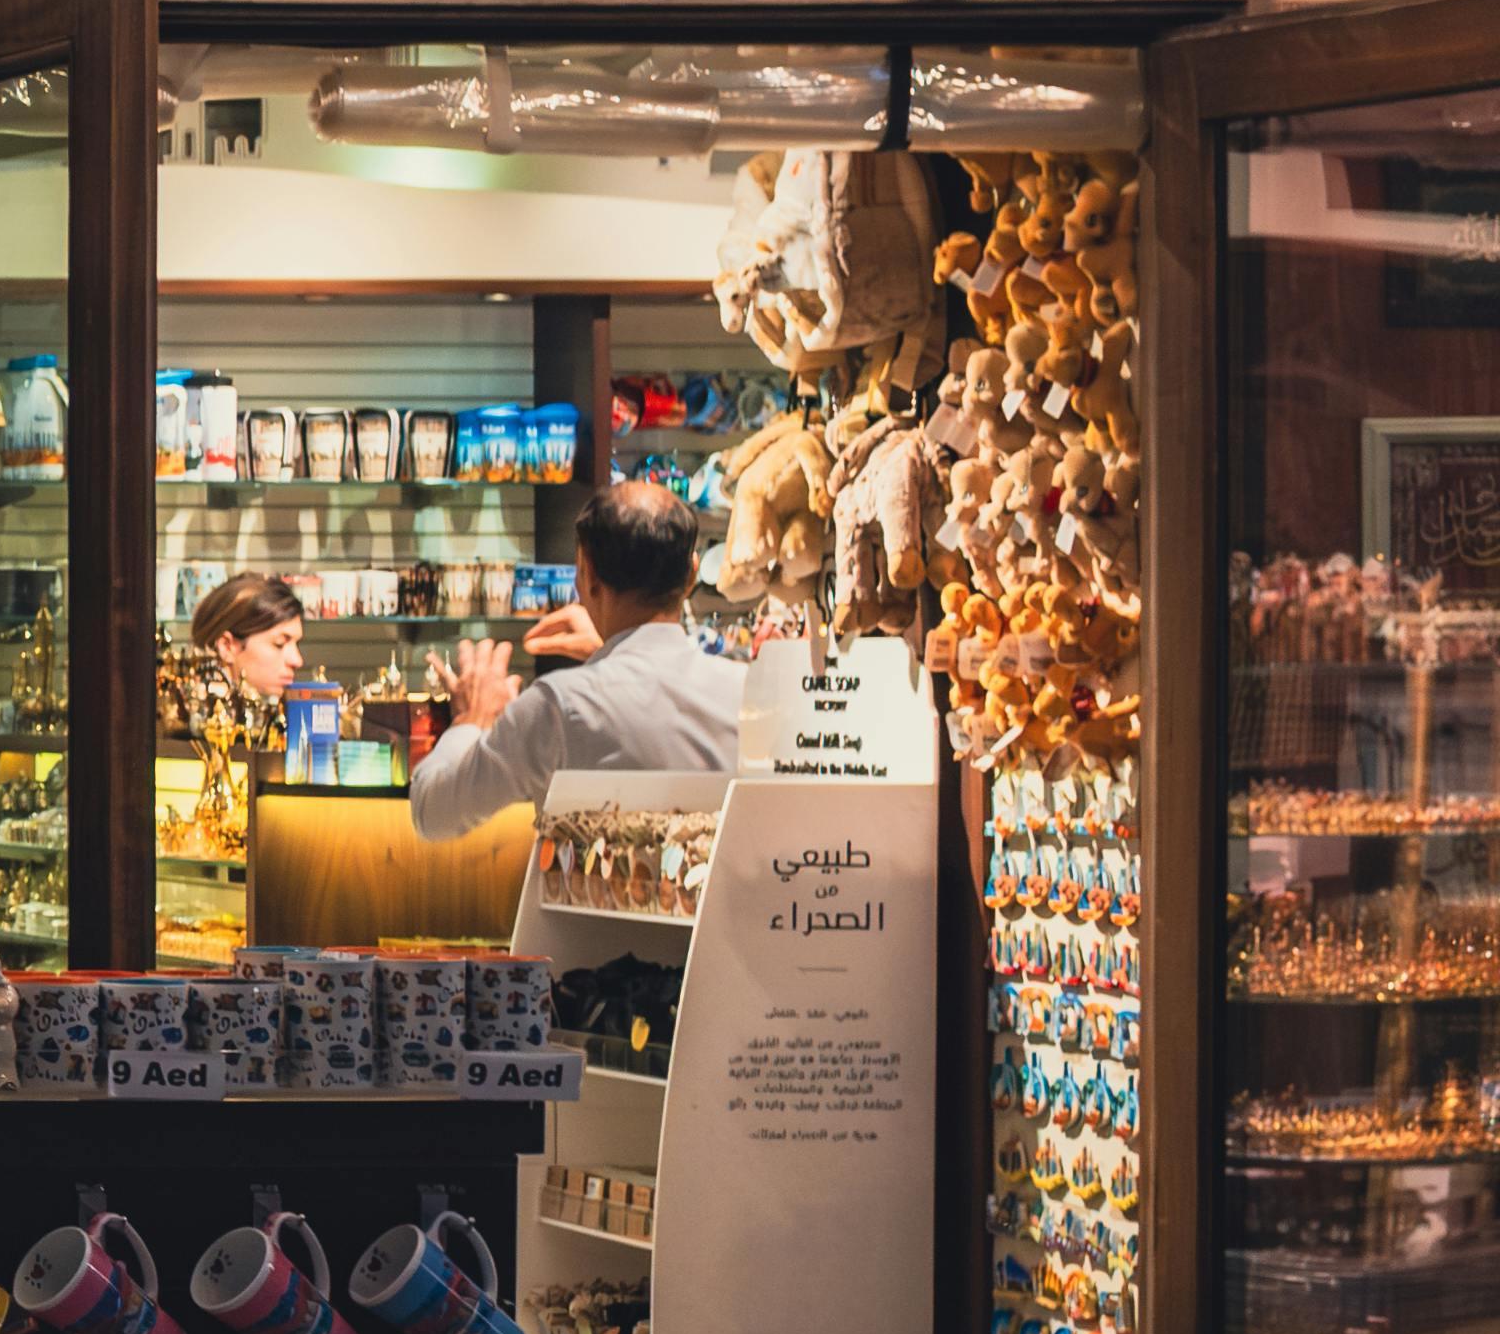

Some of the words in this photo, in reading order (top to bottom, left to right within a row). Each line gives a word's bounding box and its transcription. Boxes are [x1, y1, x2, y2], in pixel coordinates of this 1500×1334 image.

[773, 839, 871, 883] طبيعي
[814, 883, 839, 899] من
[770, 901, 884, 936] الصحراء
[112, 1060, 131, 1085] 9
[141, 1061, 207, 1087] Aed
[468, 1062, 487, 1086] 9
[497, 1064, 563, 1088] Aed
